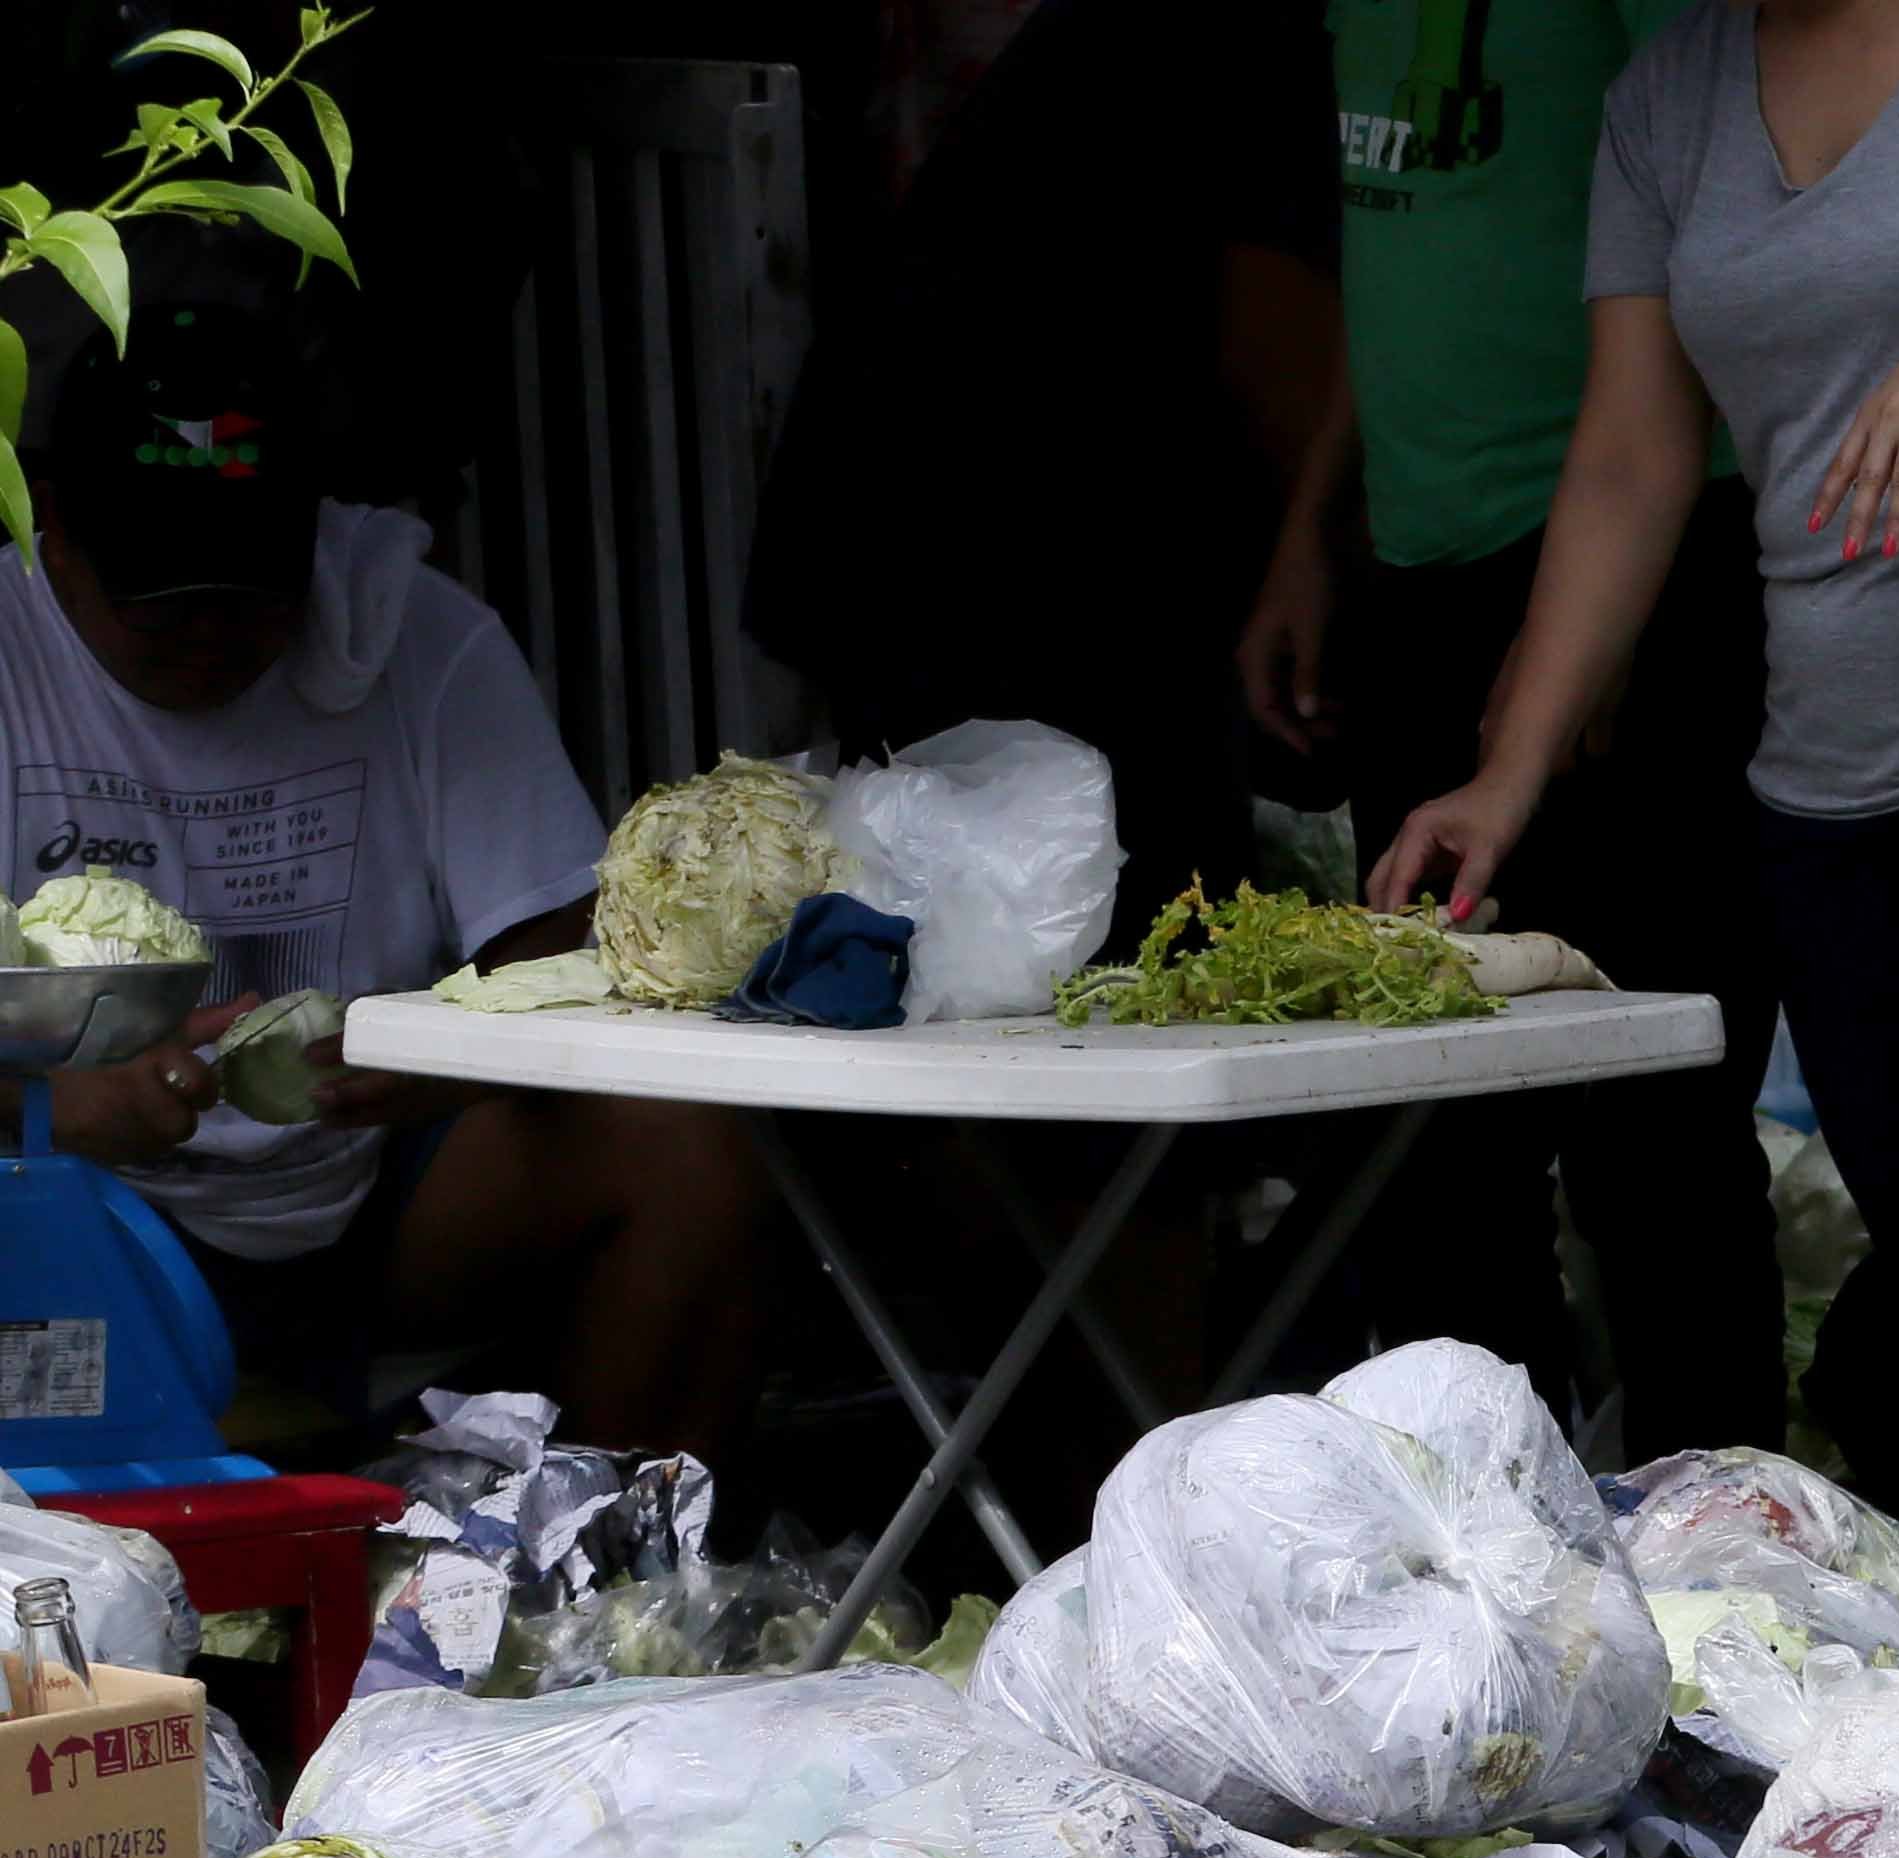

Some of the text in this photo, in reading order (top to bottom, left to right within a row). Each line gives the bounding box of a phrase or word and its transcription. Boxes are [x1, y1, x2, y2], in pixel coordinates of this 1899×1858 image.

[160, 790, 276, 815] RUNNING
[226, 808, 323, 840] WITH YOU
[80, 837, 158, 868] asics
[216, 841, 276, 859] SINCE
[224, 866, 310, 890] MADE IN
[232, 889, 297, 909] JAPAN
